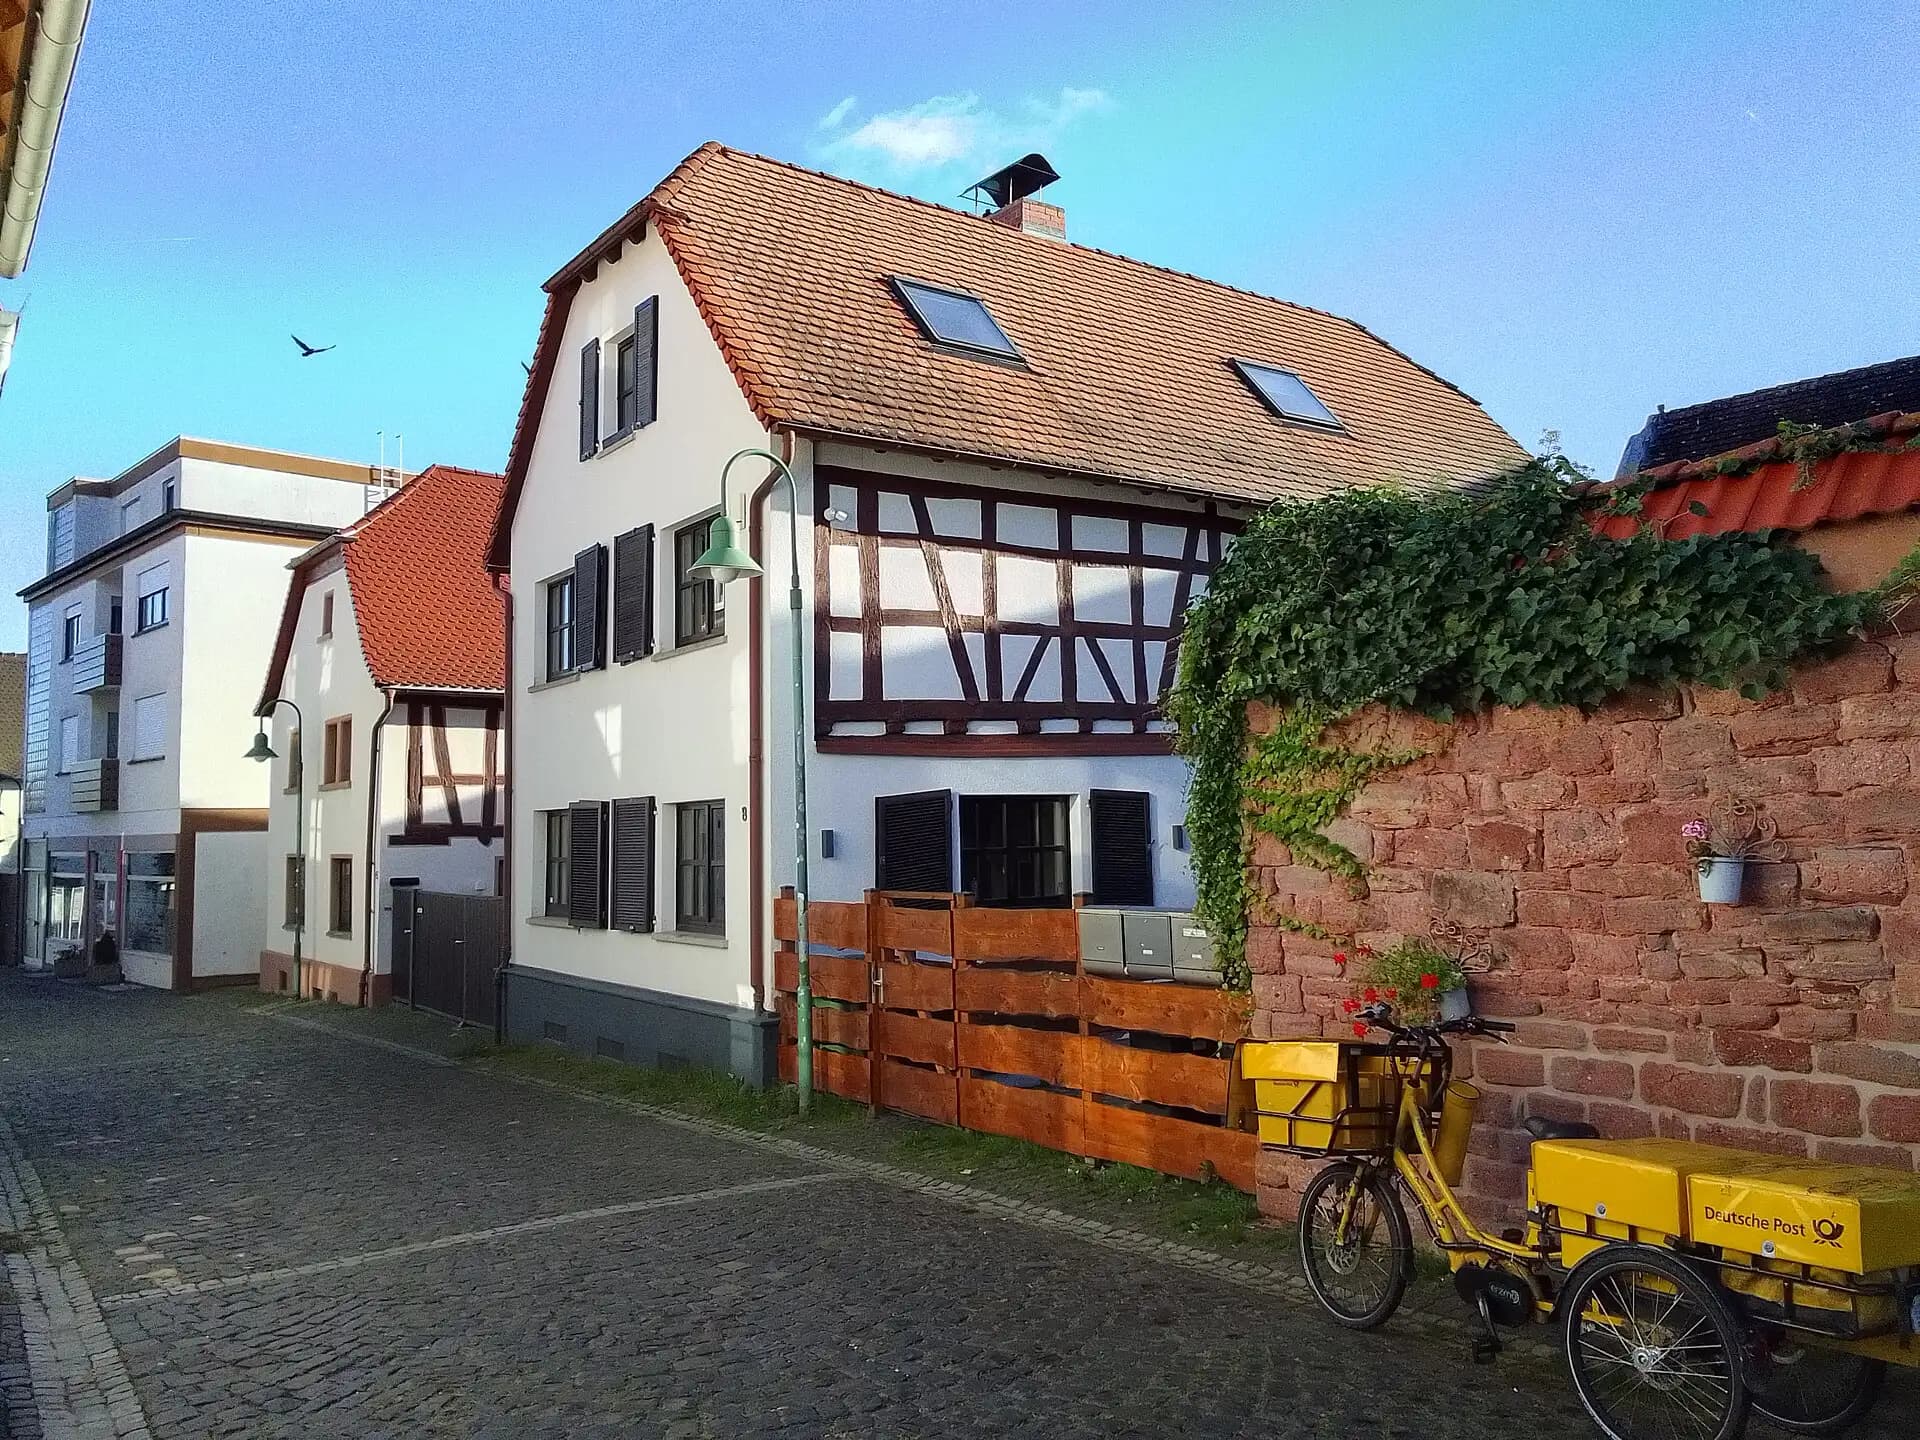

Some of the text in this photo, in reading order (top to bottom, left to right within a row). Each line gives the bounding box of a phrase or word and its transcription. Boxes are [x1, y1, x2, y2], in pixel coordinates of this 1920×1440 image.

[741, 806, 748, 822] 8
[1704, 1206, 1806, 1237] Deutsche Post
